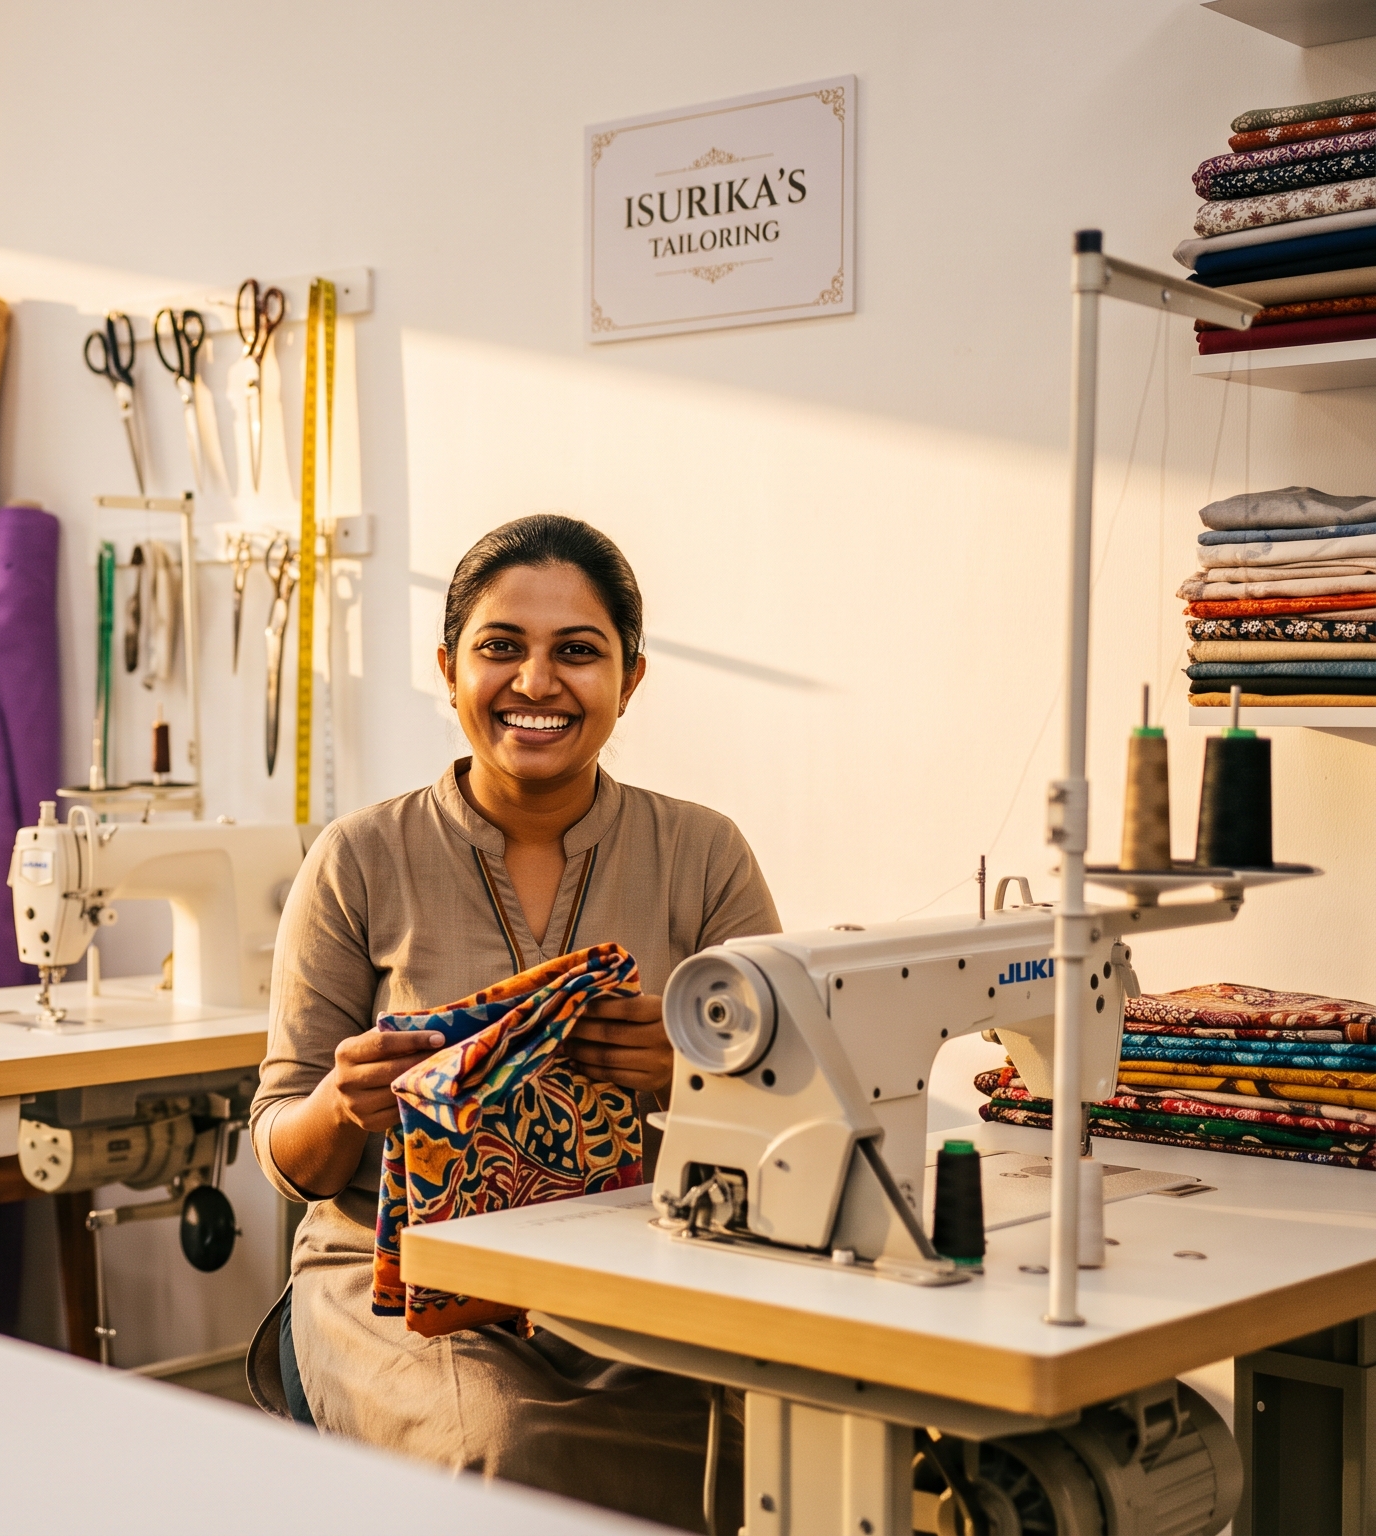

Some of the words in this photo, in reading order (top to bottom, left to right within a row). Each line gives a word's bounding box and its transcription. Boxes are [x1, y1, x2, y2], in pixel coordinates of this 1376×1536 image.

[624, 167, 807, 229] ISURIKA'S
[649, 220, 780, 259] TAILORING
[999, 958, 1054, 985] JUKI
